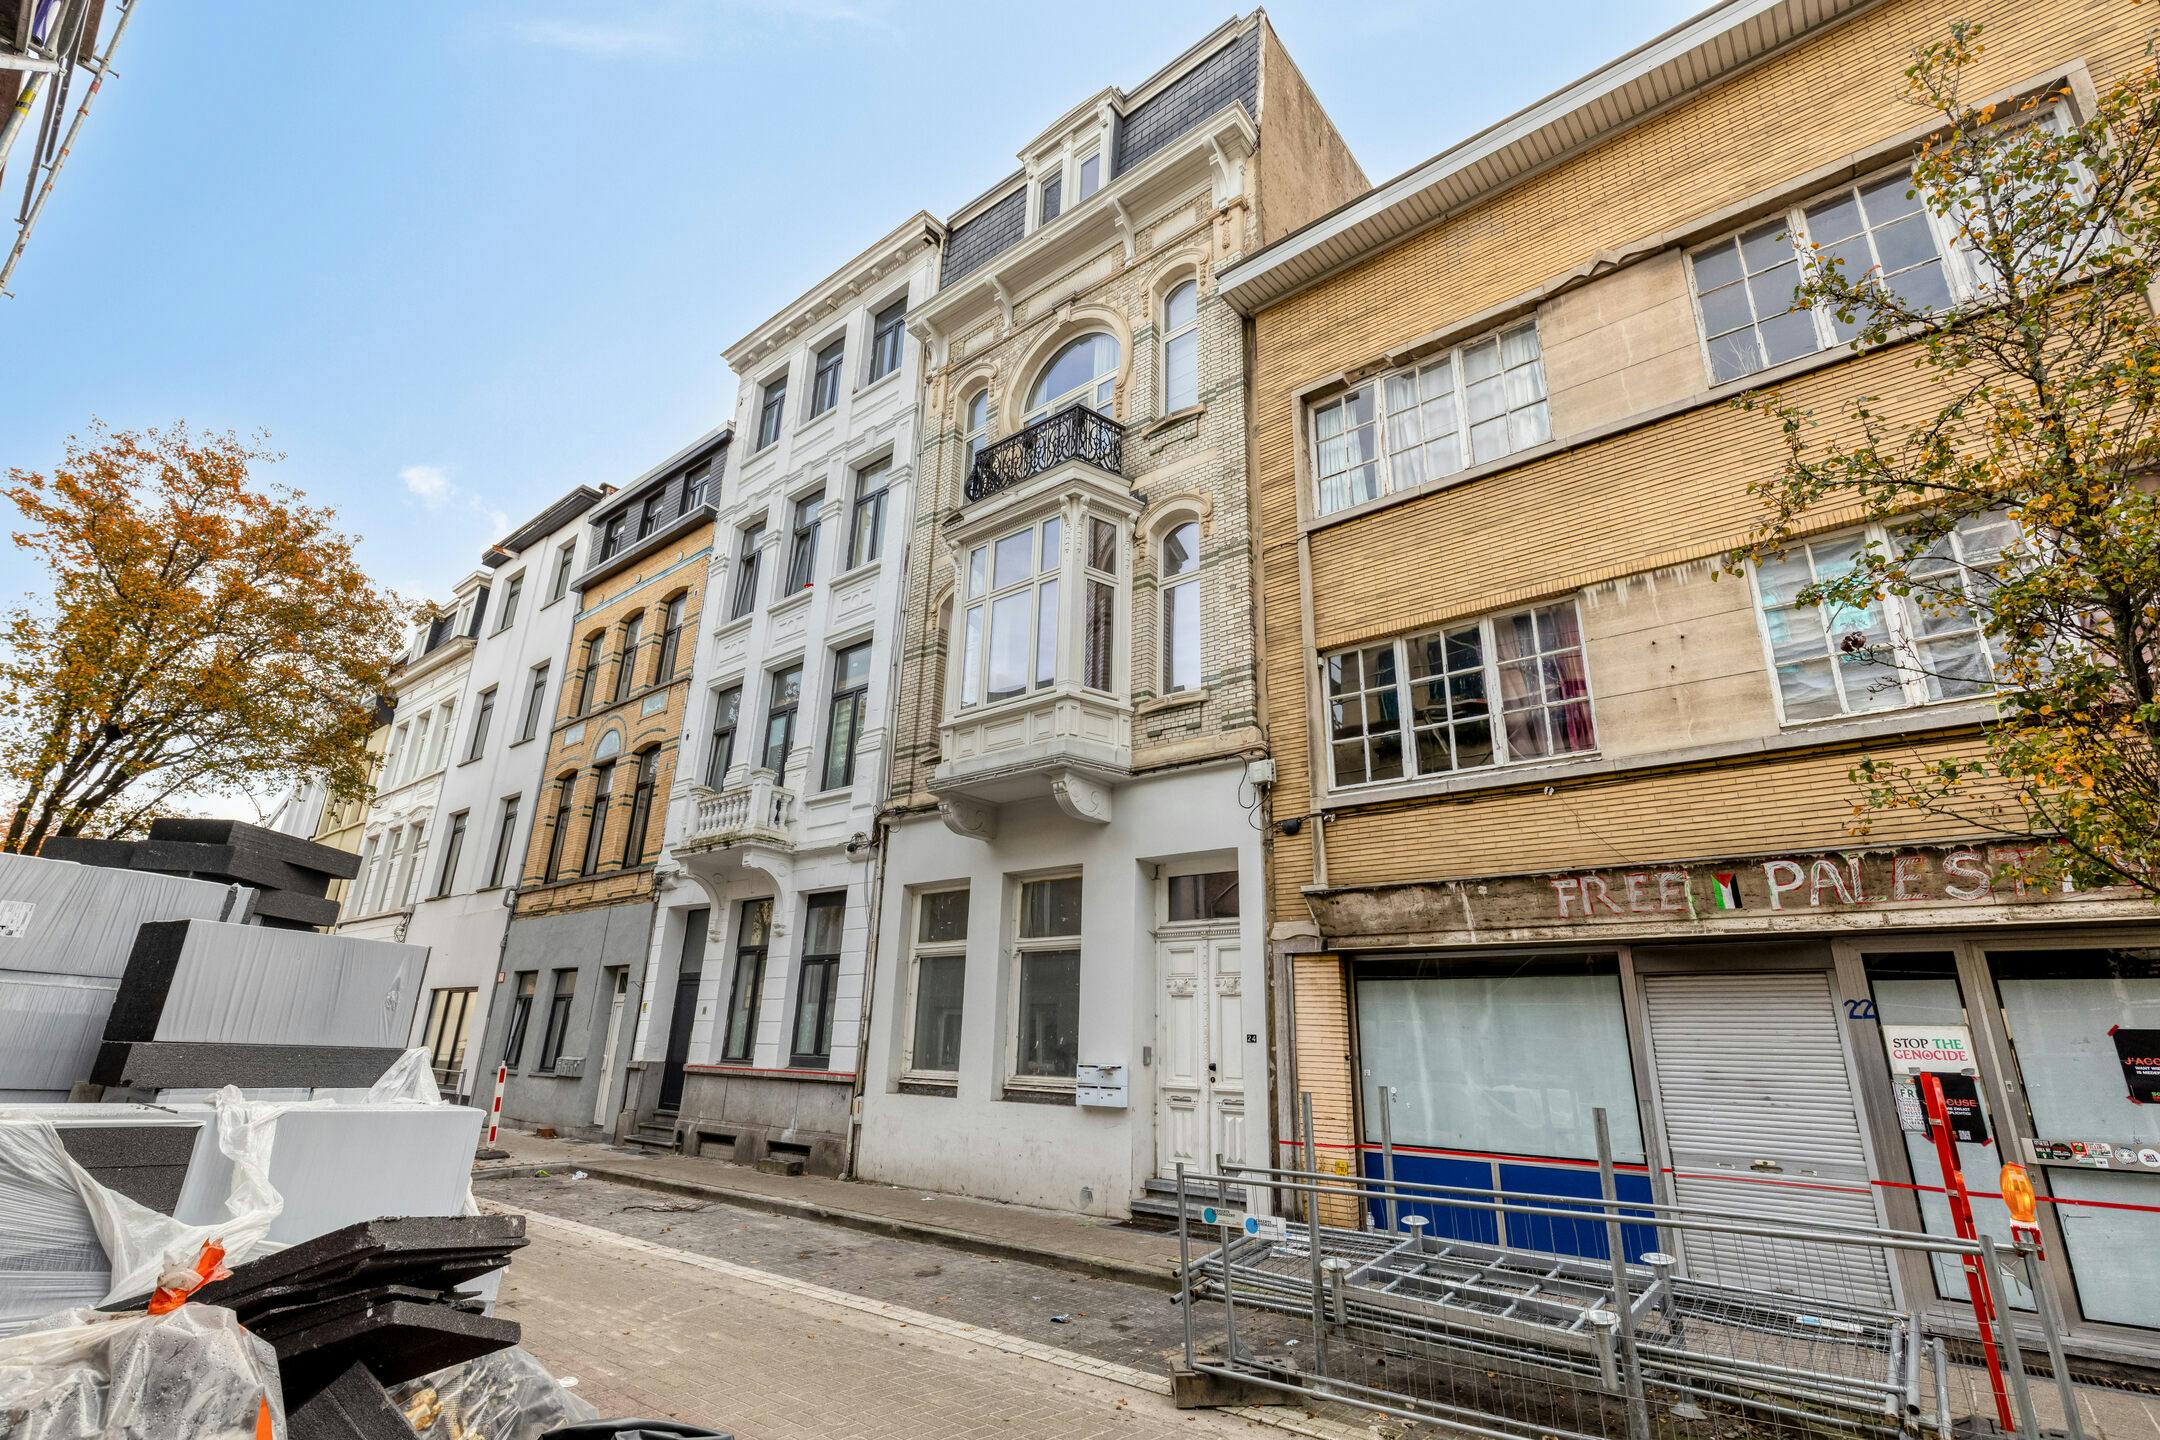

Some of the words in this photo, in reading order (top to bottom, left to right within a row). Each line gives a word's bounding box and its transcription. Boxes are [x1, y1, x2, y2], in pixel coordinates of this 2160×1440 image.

[1551, 870, 1690, 919] FREE
[1844, 999, 1876, 1020] 22
[1893, 1038, 1929, 1049] STOP
[1932, 1039, 1964, 1050] THE
[1893, 1049, 1968, 1061] GENOCIDE
[1900, 1088, 1915, 1098] FR
